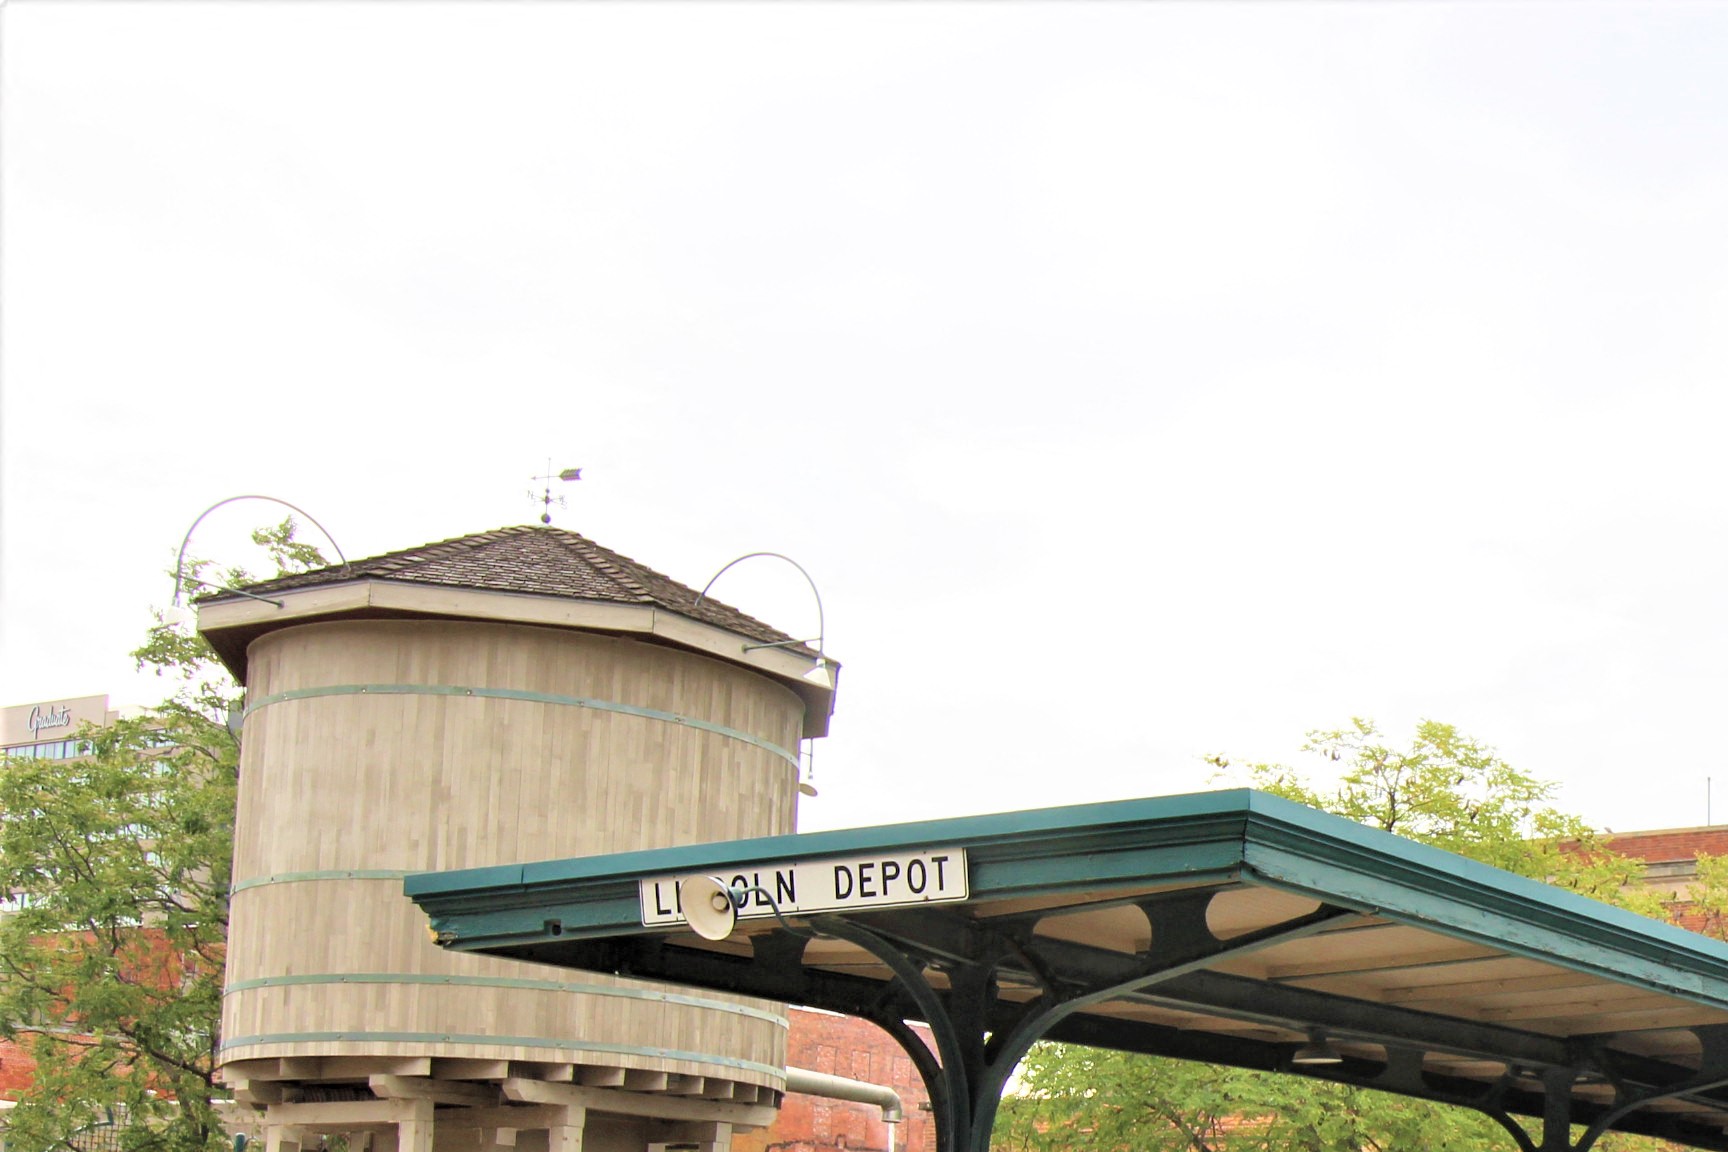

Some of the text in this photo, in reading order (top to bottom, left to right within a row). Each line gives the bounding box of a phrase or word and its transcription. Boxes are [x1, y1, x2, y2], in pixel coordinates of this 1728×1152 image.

[28, 705, 71, 740] Graduate
[655, 856, 949, 915] LIOLN DEPOT
